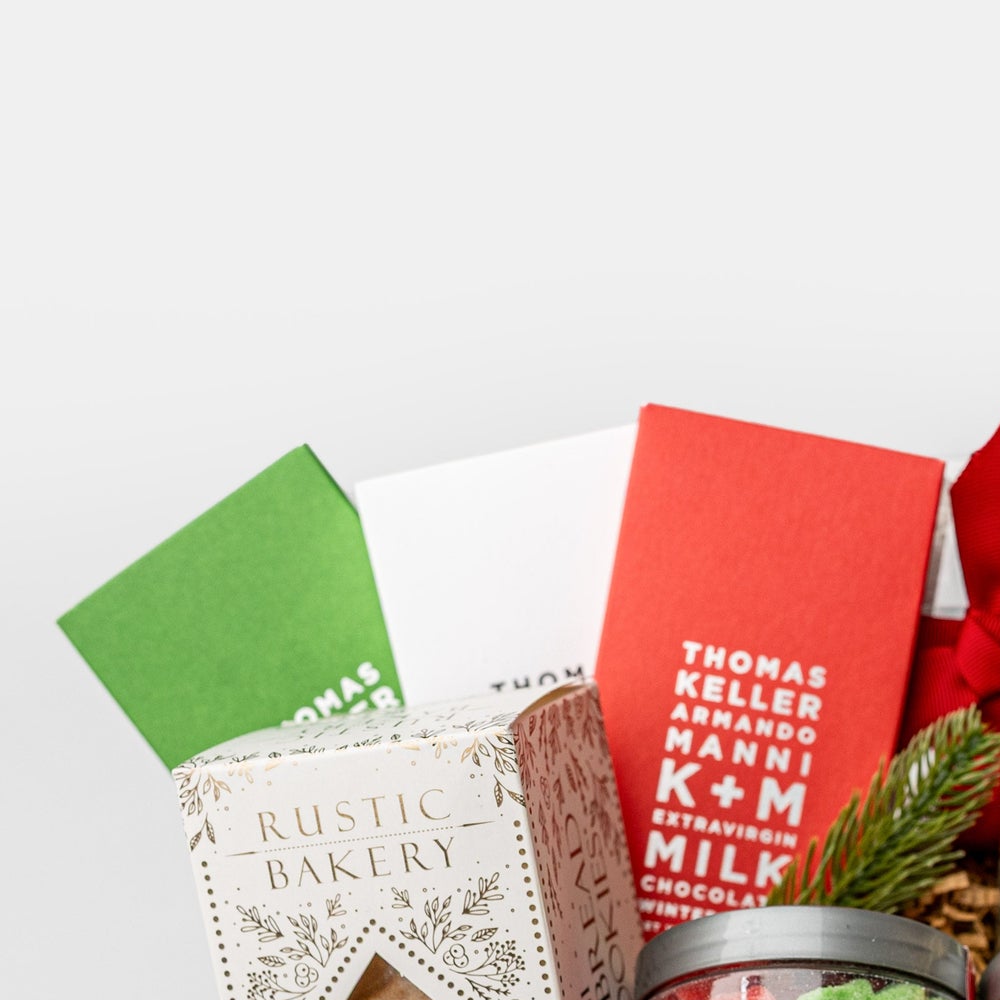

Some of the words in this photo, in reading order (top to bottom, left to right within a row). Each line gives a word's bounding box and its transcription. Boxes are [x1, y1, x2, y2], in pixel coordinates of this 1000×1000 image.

[682, 640, 827, 689] THOMAS
[281, 661, 381, 725] OMAS
[674, 669, 822, 721] KELLER
[670, 702, 816, 745] ARMANDO
[664, 726, 812, 777] MANNI
[257, 788, 451, 842] RUSTIC
[651, 808, 798, 849] EXTRAVIRGIN
[265, 836, 455, 890] BAKERY
[644, 831, 793, 889] MILK
